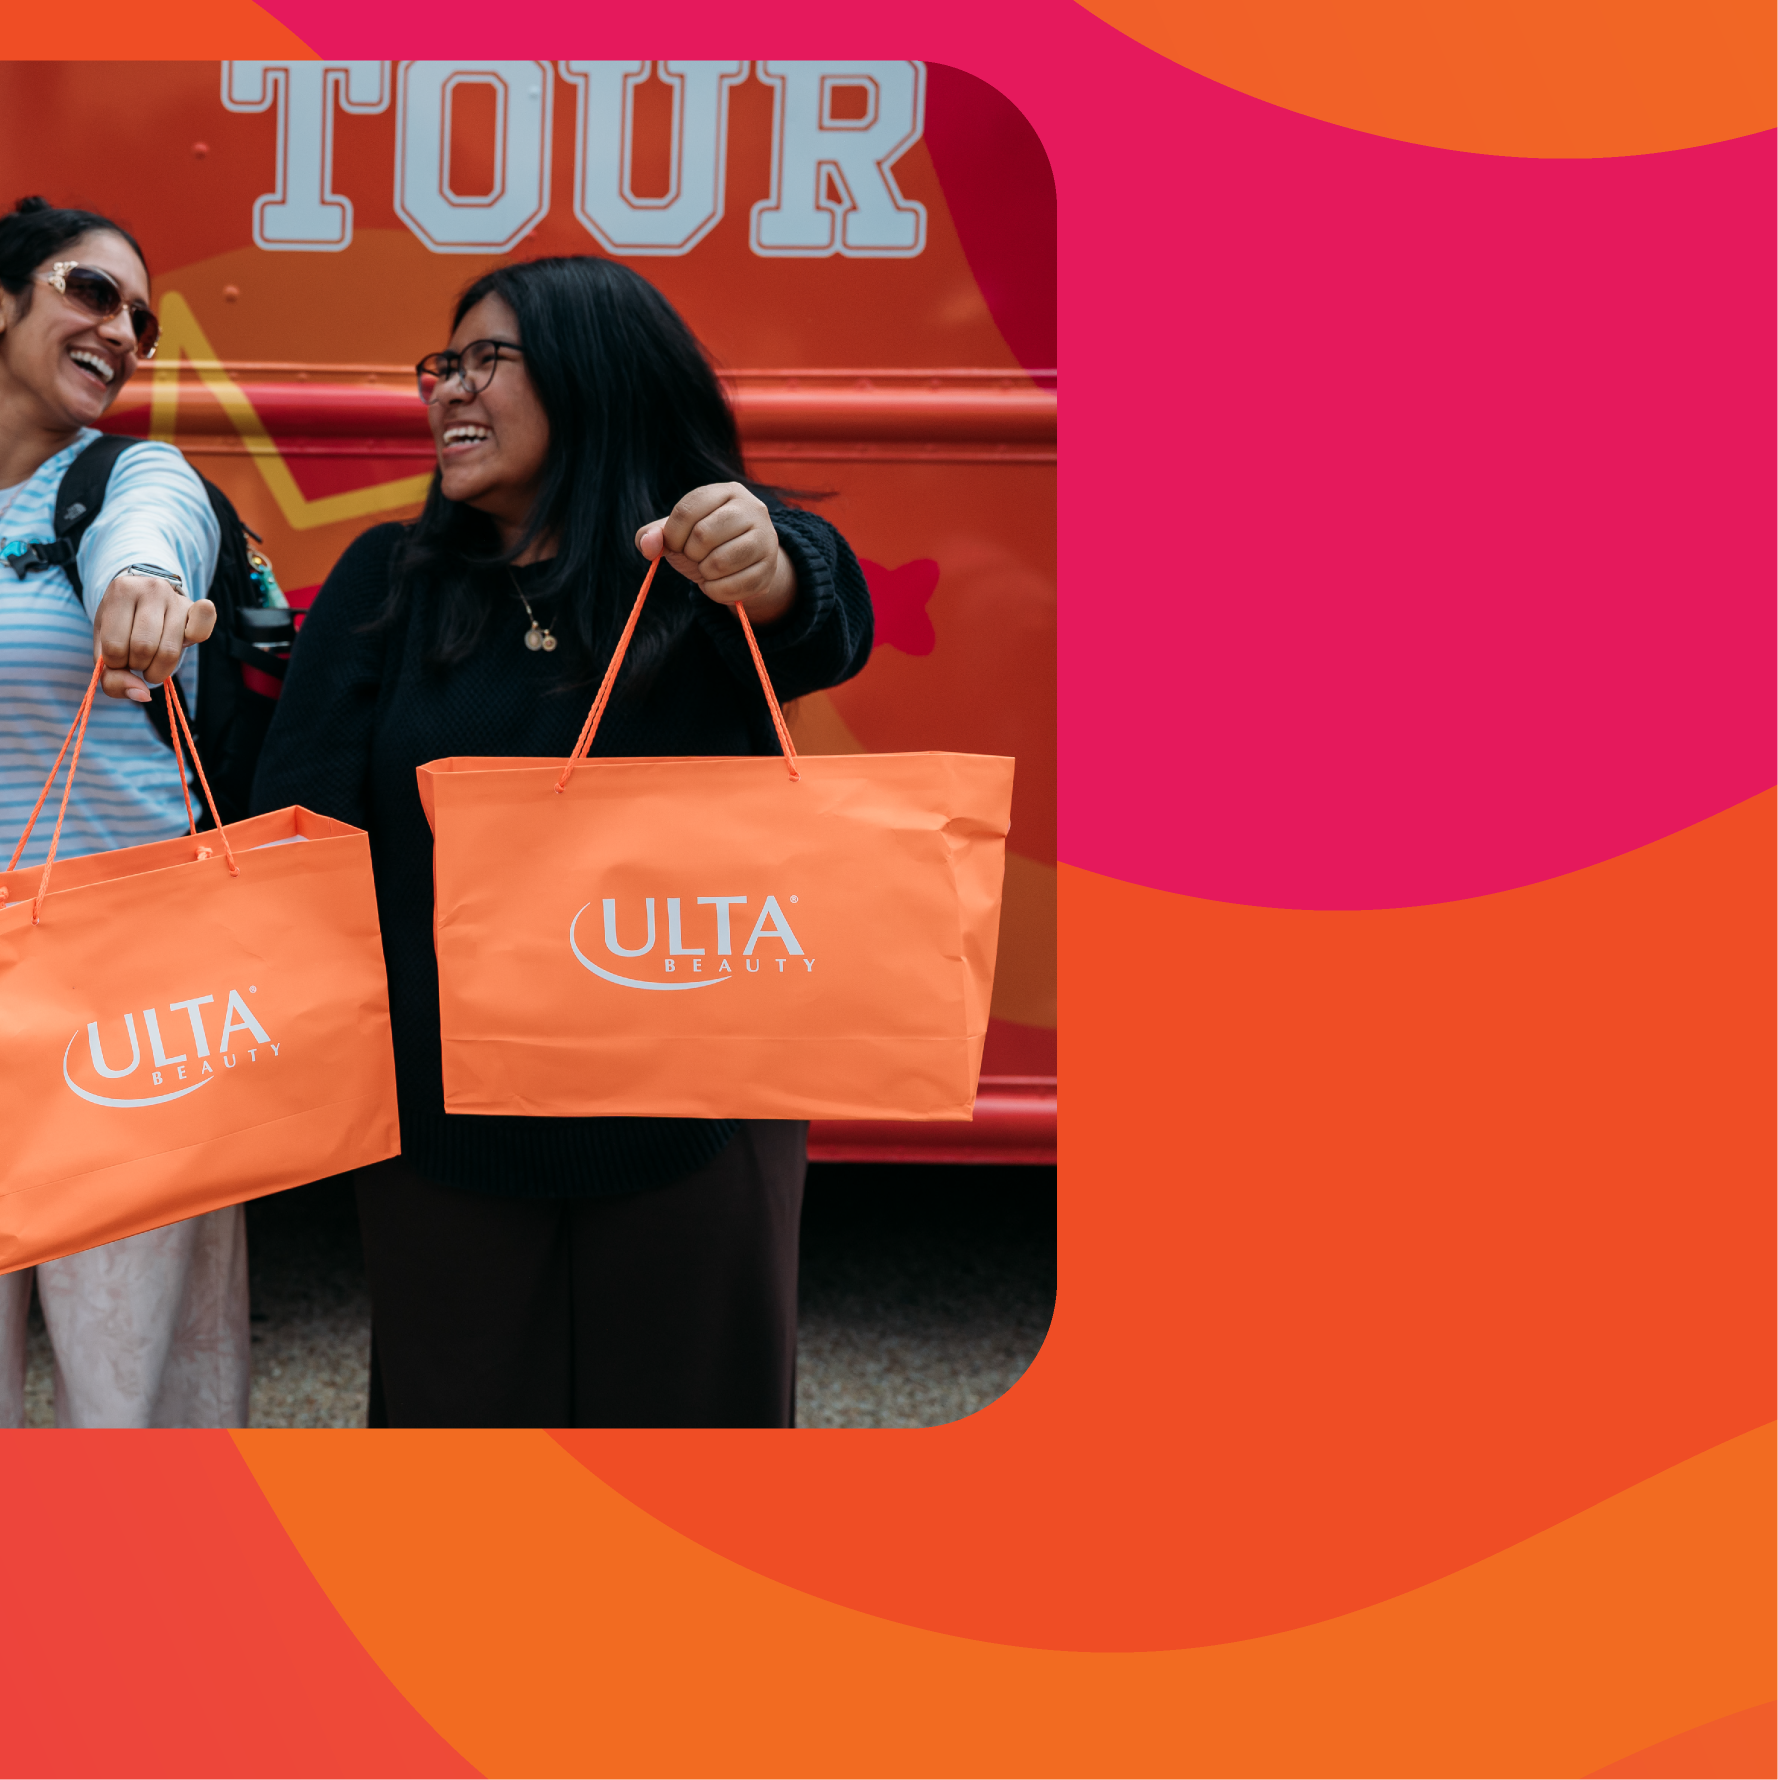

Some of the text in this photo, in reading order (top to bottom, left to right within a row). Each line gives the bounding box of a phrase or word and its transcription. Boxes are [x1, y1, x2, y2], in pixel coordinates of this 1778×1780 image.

[220, 60, 928, 259] TOUR
[602, 895, 805, 958] ULTA
[664, 958, 816, 973] BEAUTY
[86, 988, 272, 1080] ULTA
[151, 1042, 281, 1086] BEAUTY
